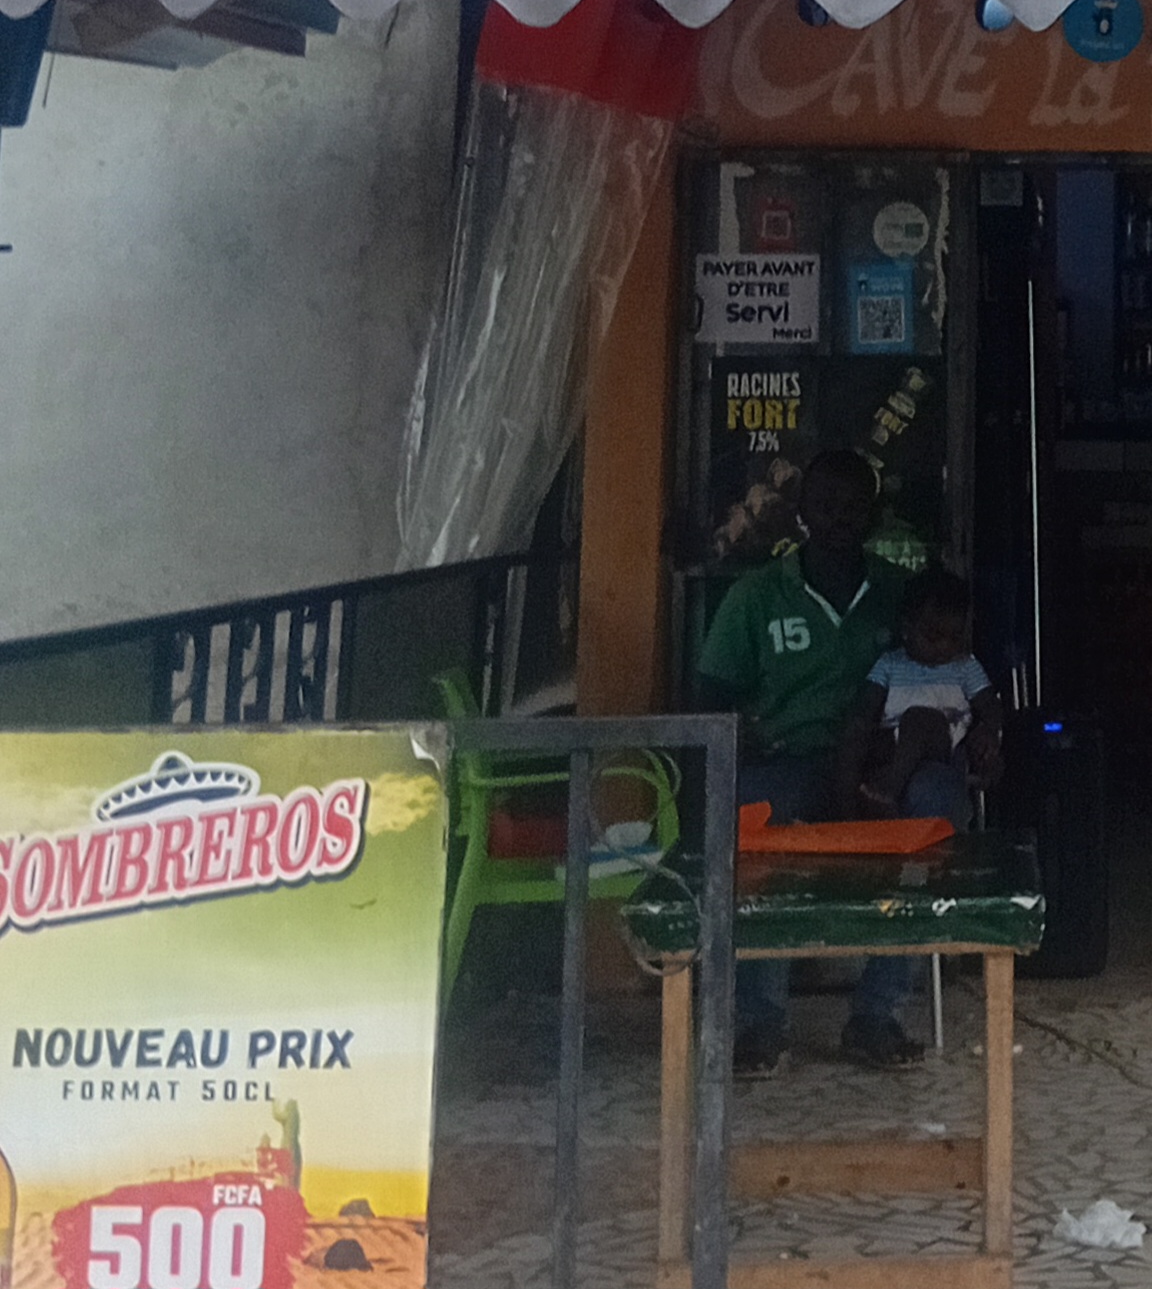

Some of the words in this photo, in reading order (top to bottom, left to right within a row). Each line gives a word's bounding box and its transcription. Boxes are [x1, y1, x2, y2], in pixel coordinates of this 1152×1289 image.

[702, 261, 757, 277] PAYER
[762, 261, 815, 276] AVANT
[726, 300, 789, 324] Servi
[773, 326, 813, 340] Merci
[727, 372, 801, 398] RACINES
[727, 398, 801, 431] FORT
[767, 616, 811, 654] 15
[12, 1028, 229, 1069] NOUVEAU
[248, 1029, 354, 1069] PRIX
[62, 1080, 181, 1101] FORMAT
[201, 1079, 275, 1101] 50CL
[212, 1184, 262, 1206] FCFA
[87, 1206, 266, 1289] 500
